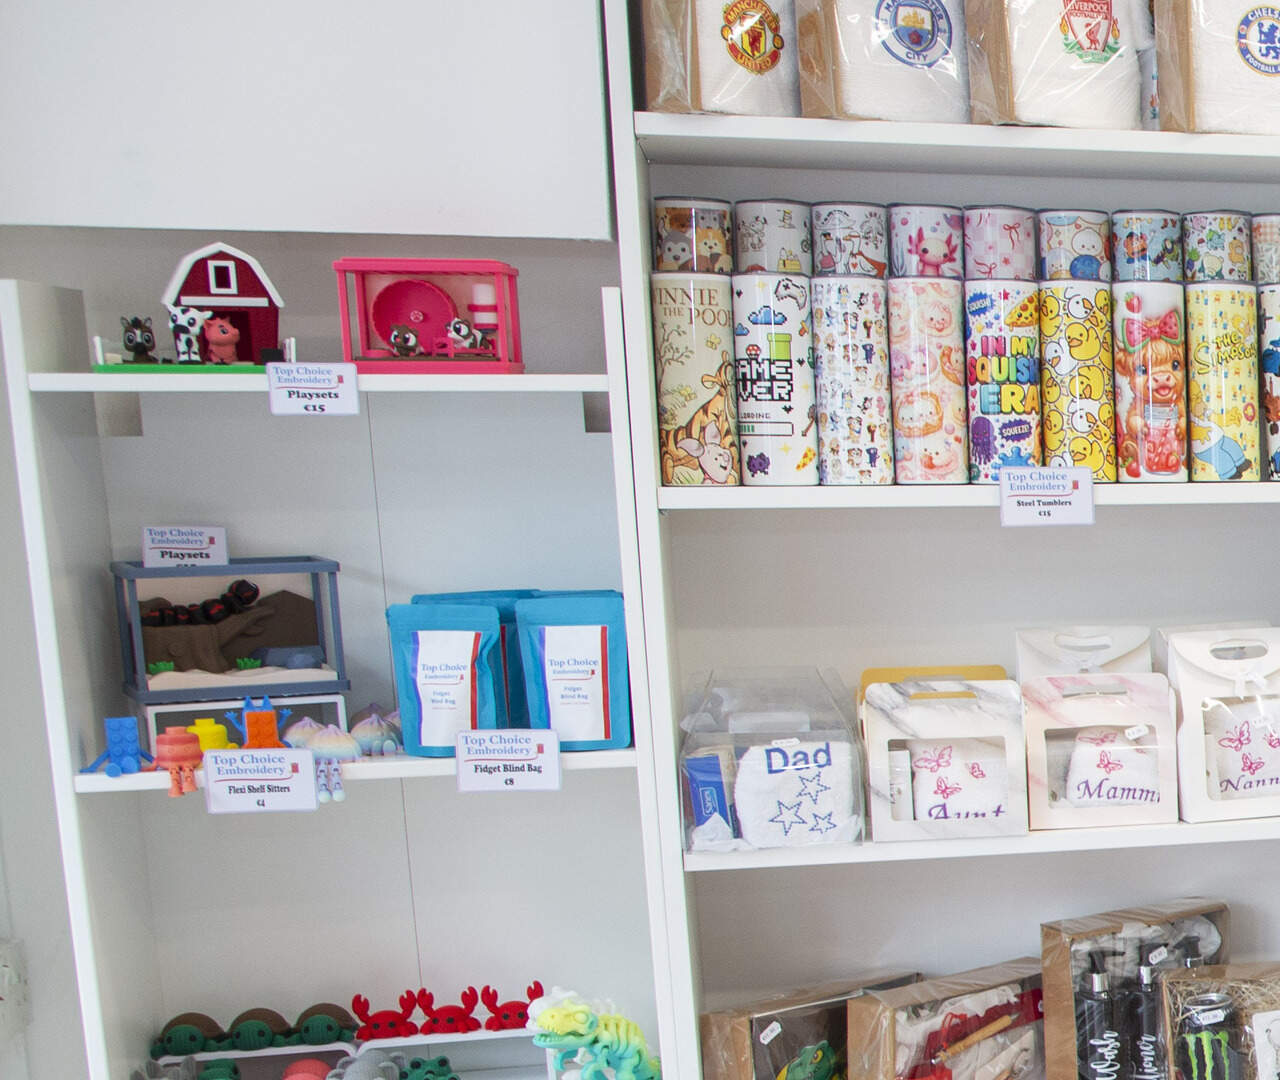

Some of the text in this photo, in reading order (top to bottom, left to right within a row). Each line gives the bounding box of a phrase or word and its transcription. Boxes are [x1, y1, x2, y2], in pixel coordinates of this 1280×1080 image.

[905, 51, 928, 62] CITY
[1245, 53, 1277, 74] FOOTBALL
[656, 287, 719, 307] INNIE
[663, 307, 684, 317] THE
[1216, 332, 1240, 349] THE
[980, 336, 1037, 356] IN MY
[273, 367, 332, 376] Top Choice
[735, 359, 793, 381] AME
[278, 376, 331, 385] Embroidery
[287, 390, 339, 400] Playsets
[737, 380, 793, 401] VER
[980, 384, 1040, 415] ERA
[1006, 471, 1067, 484] Top Choice
[1009, 481, 1067, 492] Embroidery
[1037, 499, 1072, 507] Tumblers
[147, 528, 204, 537] Top Choice
[152, 538, 203, 546] Embroidery
[160, 551, 210, 560] Playsets
[422, 663, 467, 672] Top Choice
[550, 659, 599, 668] Top Choice
[553, 669, 590, 677] Embroidery
[463, 735, 532, 747] Top Choice
[467, 746, 532, 756] Embroidery
[212, 754, 285, 766] Top Choice
[765, 742, 832, 774] Dad
[217, 765, 285, 776] Embroidery
[474, 764, 543, 774] Fidget Blind Bag
[228, 784, 290, 794] Flexi Shelf Sitters
